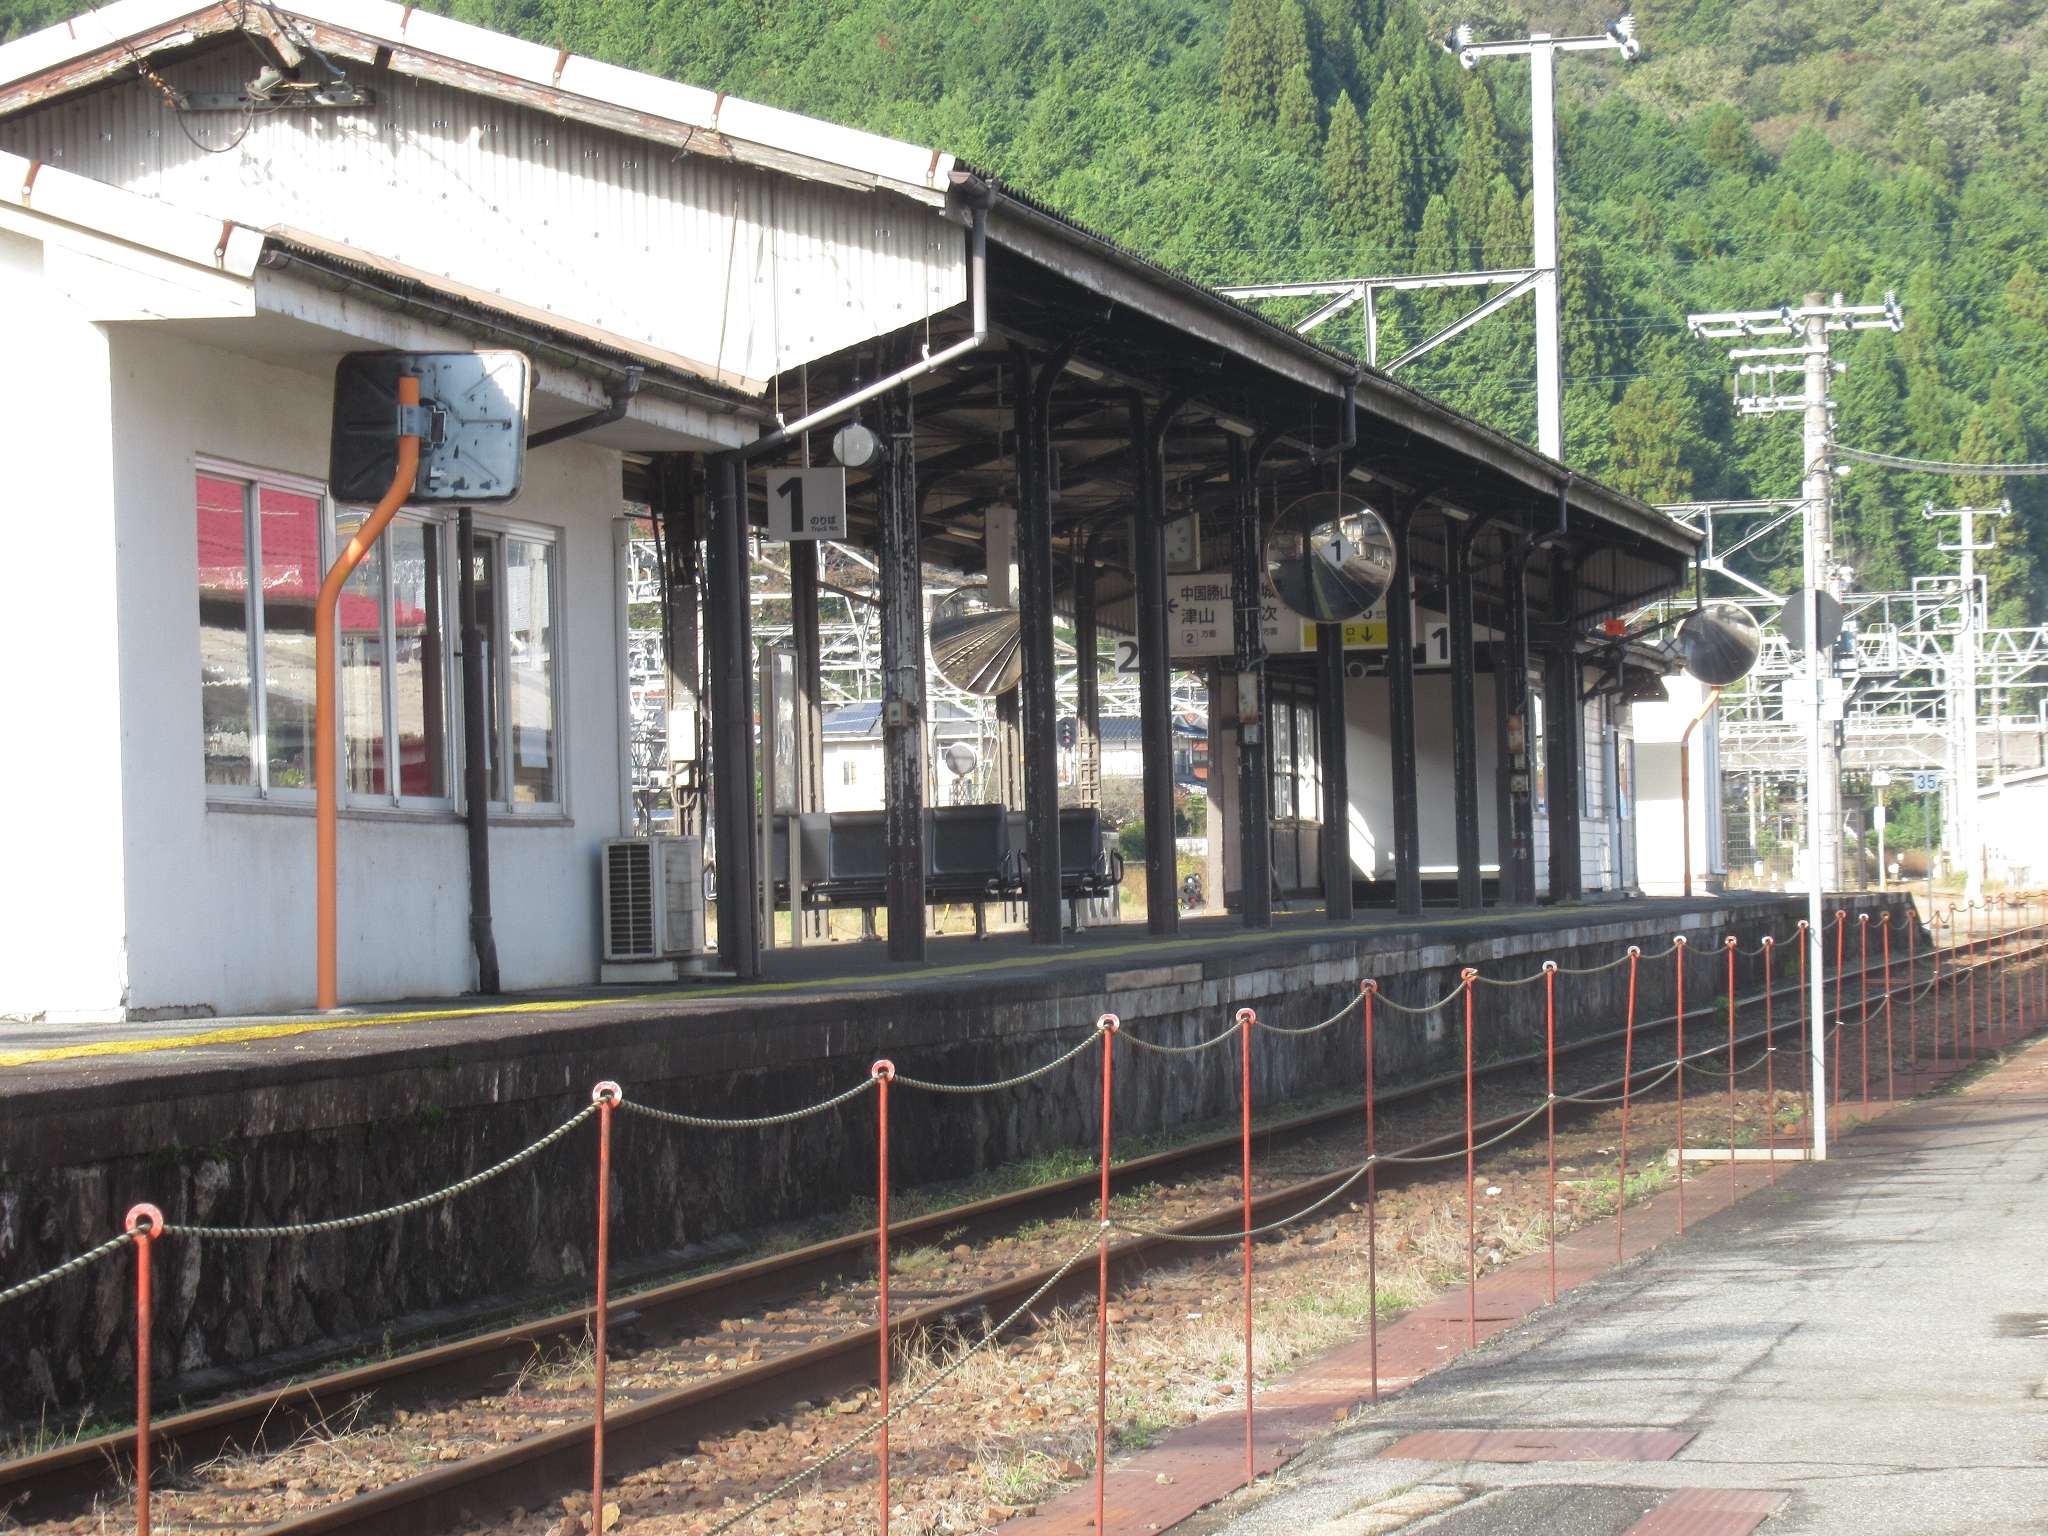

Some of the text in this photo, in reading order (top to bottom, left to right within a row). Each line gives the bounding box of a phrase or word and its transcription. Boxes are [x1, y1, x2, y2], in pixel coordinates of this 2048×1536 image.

[776, 476, 804, 533] 1
[1331, 540, 1341, 562] 1
[1181, 607, 1215, 625] 津山
[1186, 632, 1194, 644] 2
[1432, 627, 1448, 660] 1
[1118, 641, 1140, 673] 2
[1918, 774, 1937, 790] 35
